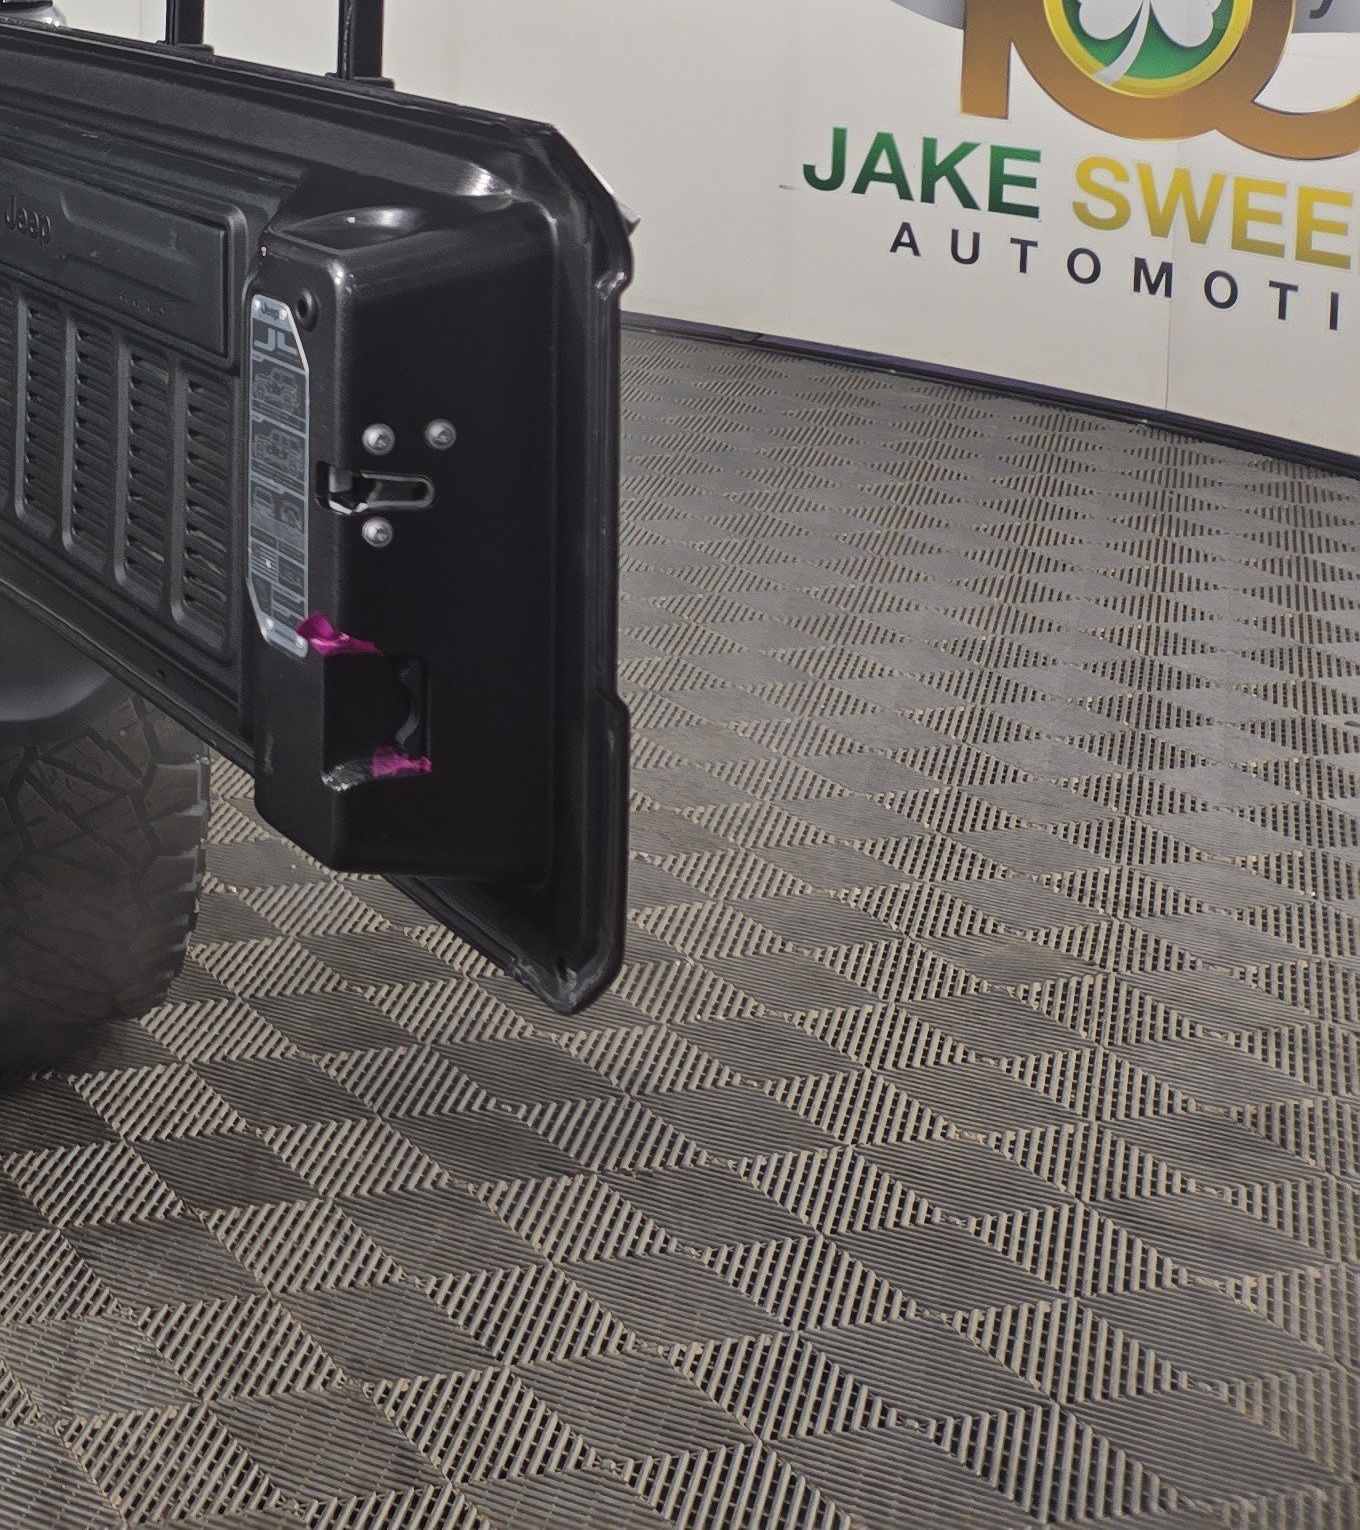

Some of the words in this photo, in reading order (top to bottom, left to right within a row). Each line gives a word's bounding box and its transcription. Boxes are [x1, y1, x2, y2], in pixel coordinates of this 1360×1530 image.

[802, 127, 1041, 219] JAKE
[1072, 155, 1354, 270] SWEE
[889, 222, 1339, 331] AUTOMOTI
